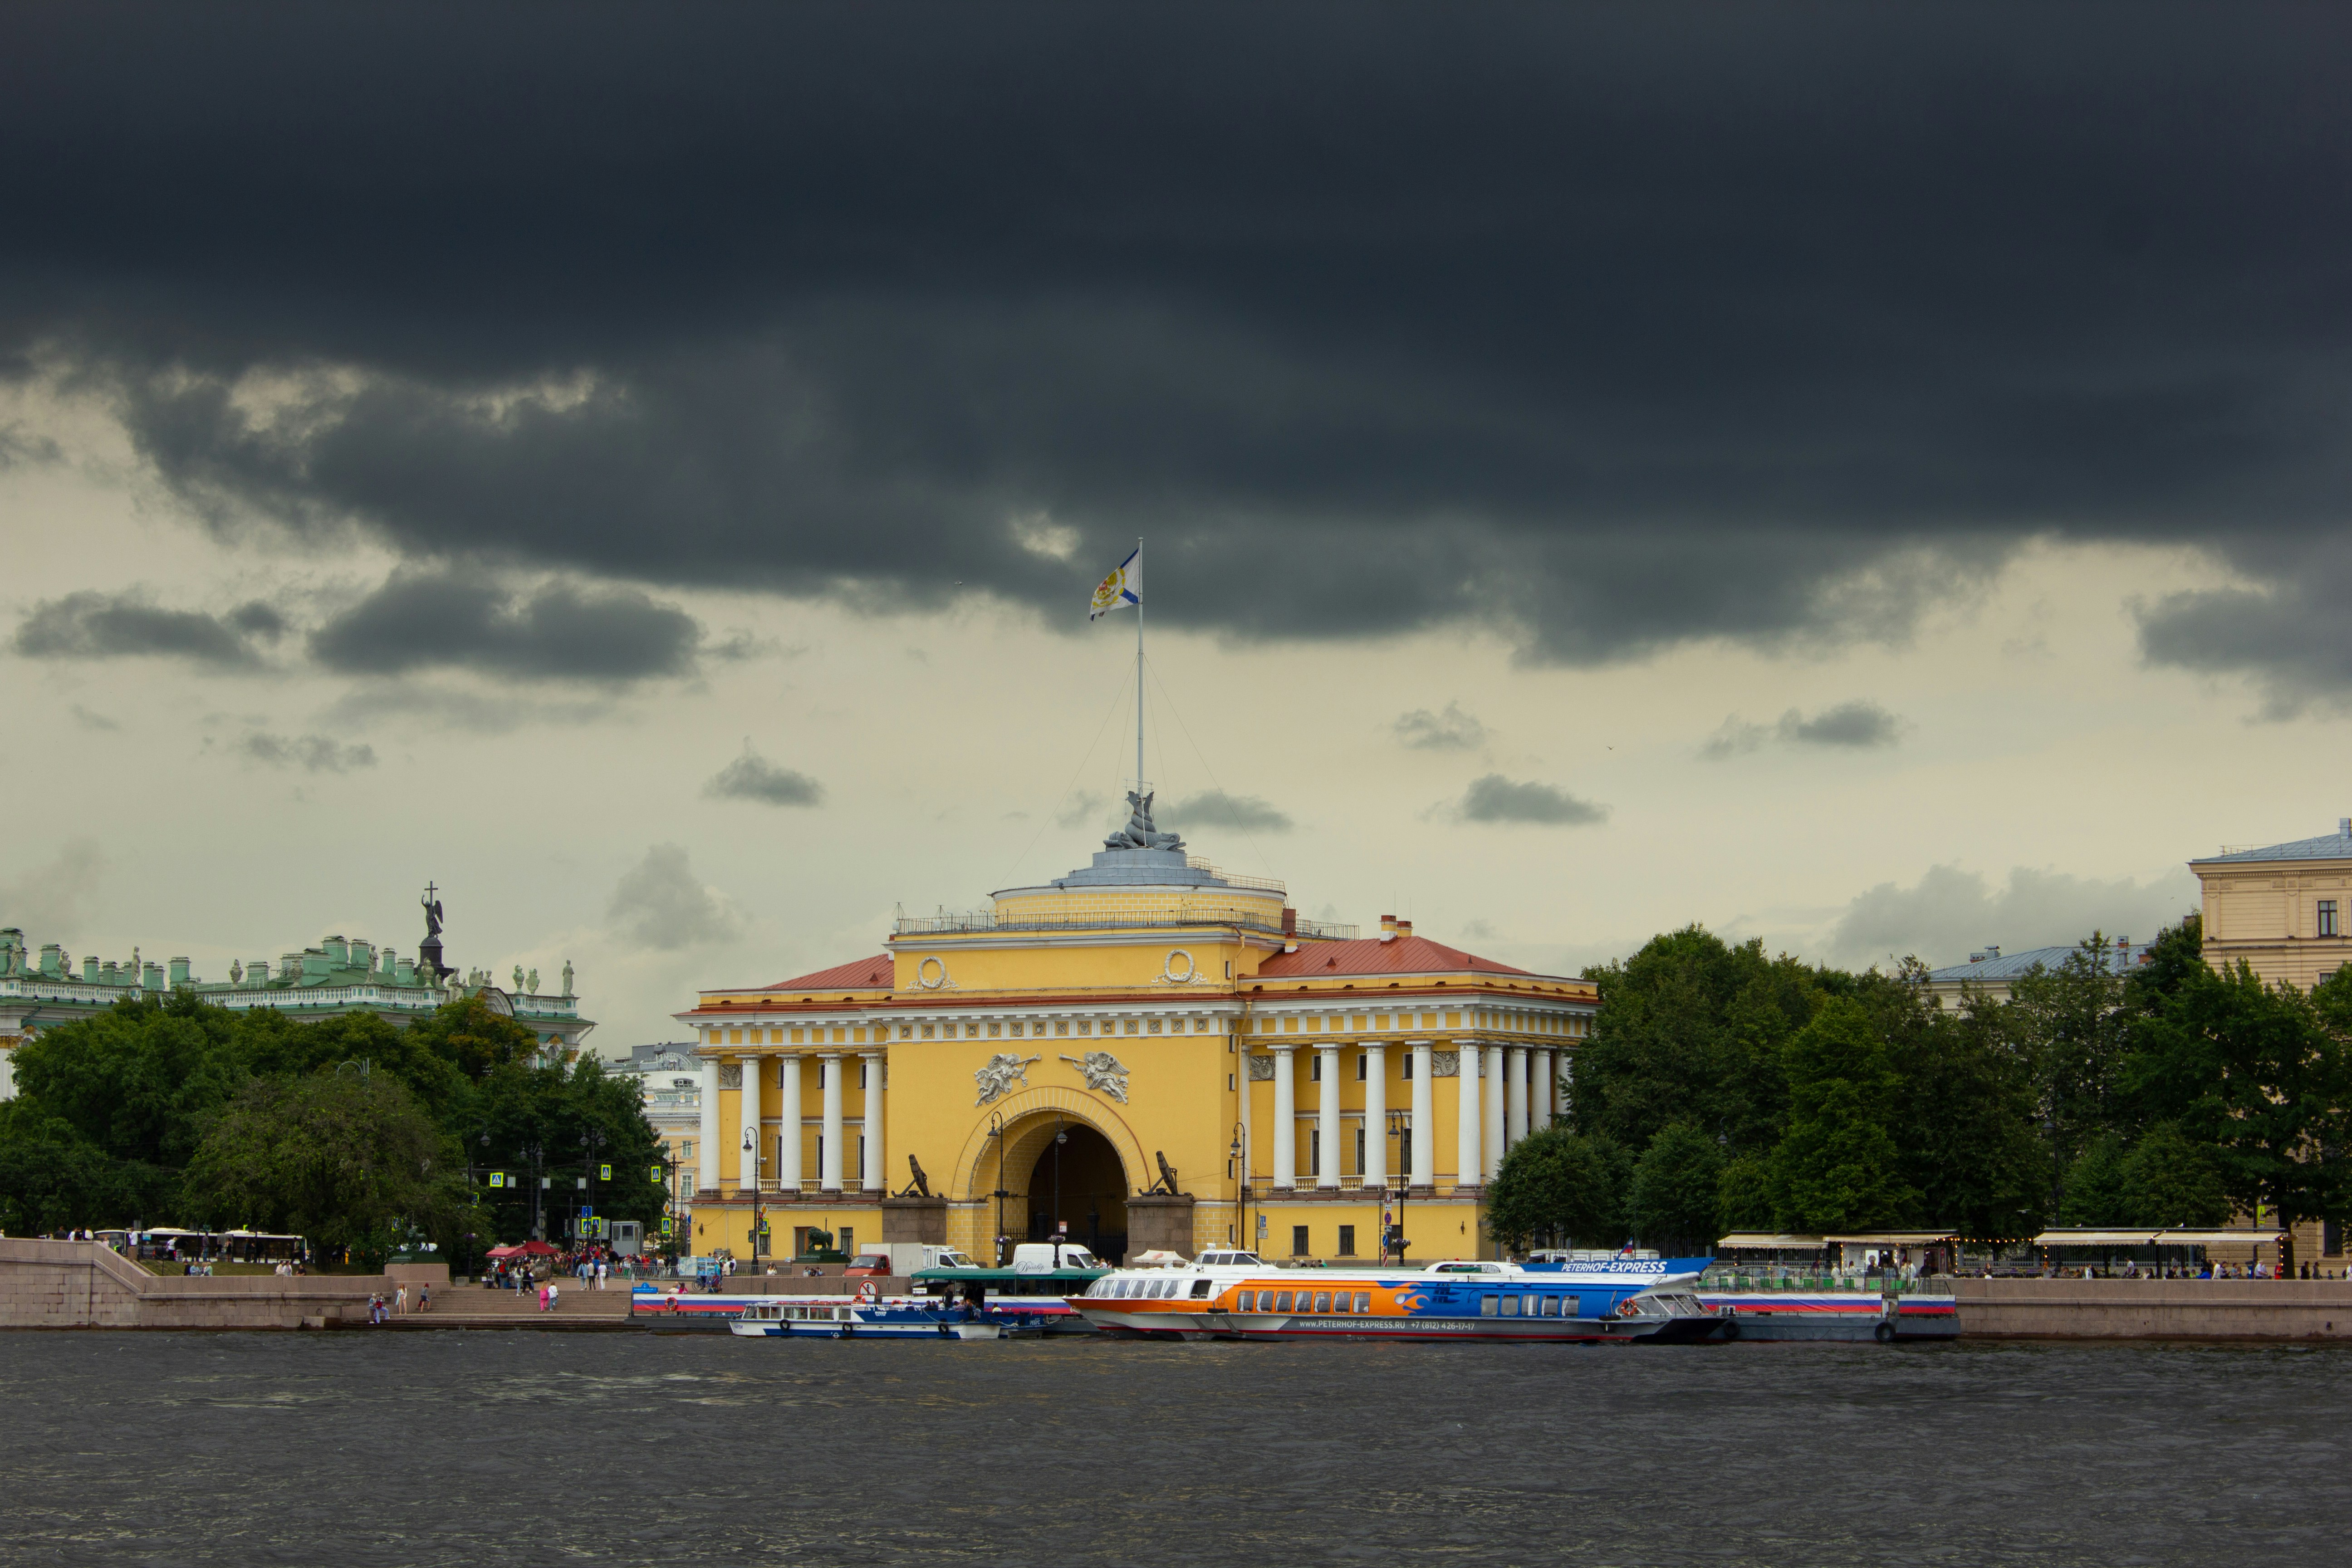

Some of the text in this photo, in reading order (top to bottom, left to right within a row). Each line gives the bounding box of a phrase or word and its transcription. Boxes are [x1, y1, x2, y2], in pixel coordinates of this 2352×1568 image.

[1561, 1261, 1667, 1273] PETERHOF-EXPRESS
[1421, 1321, 1440, 1330] (812)
[1441, 1322, 1475, 1330] 426-17-17
